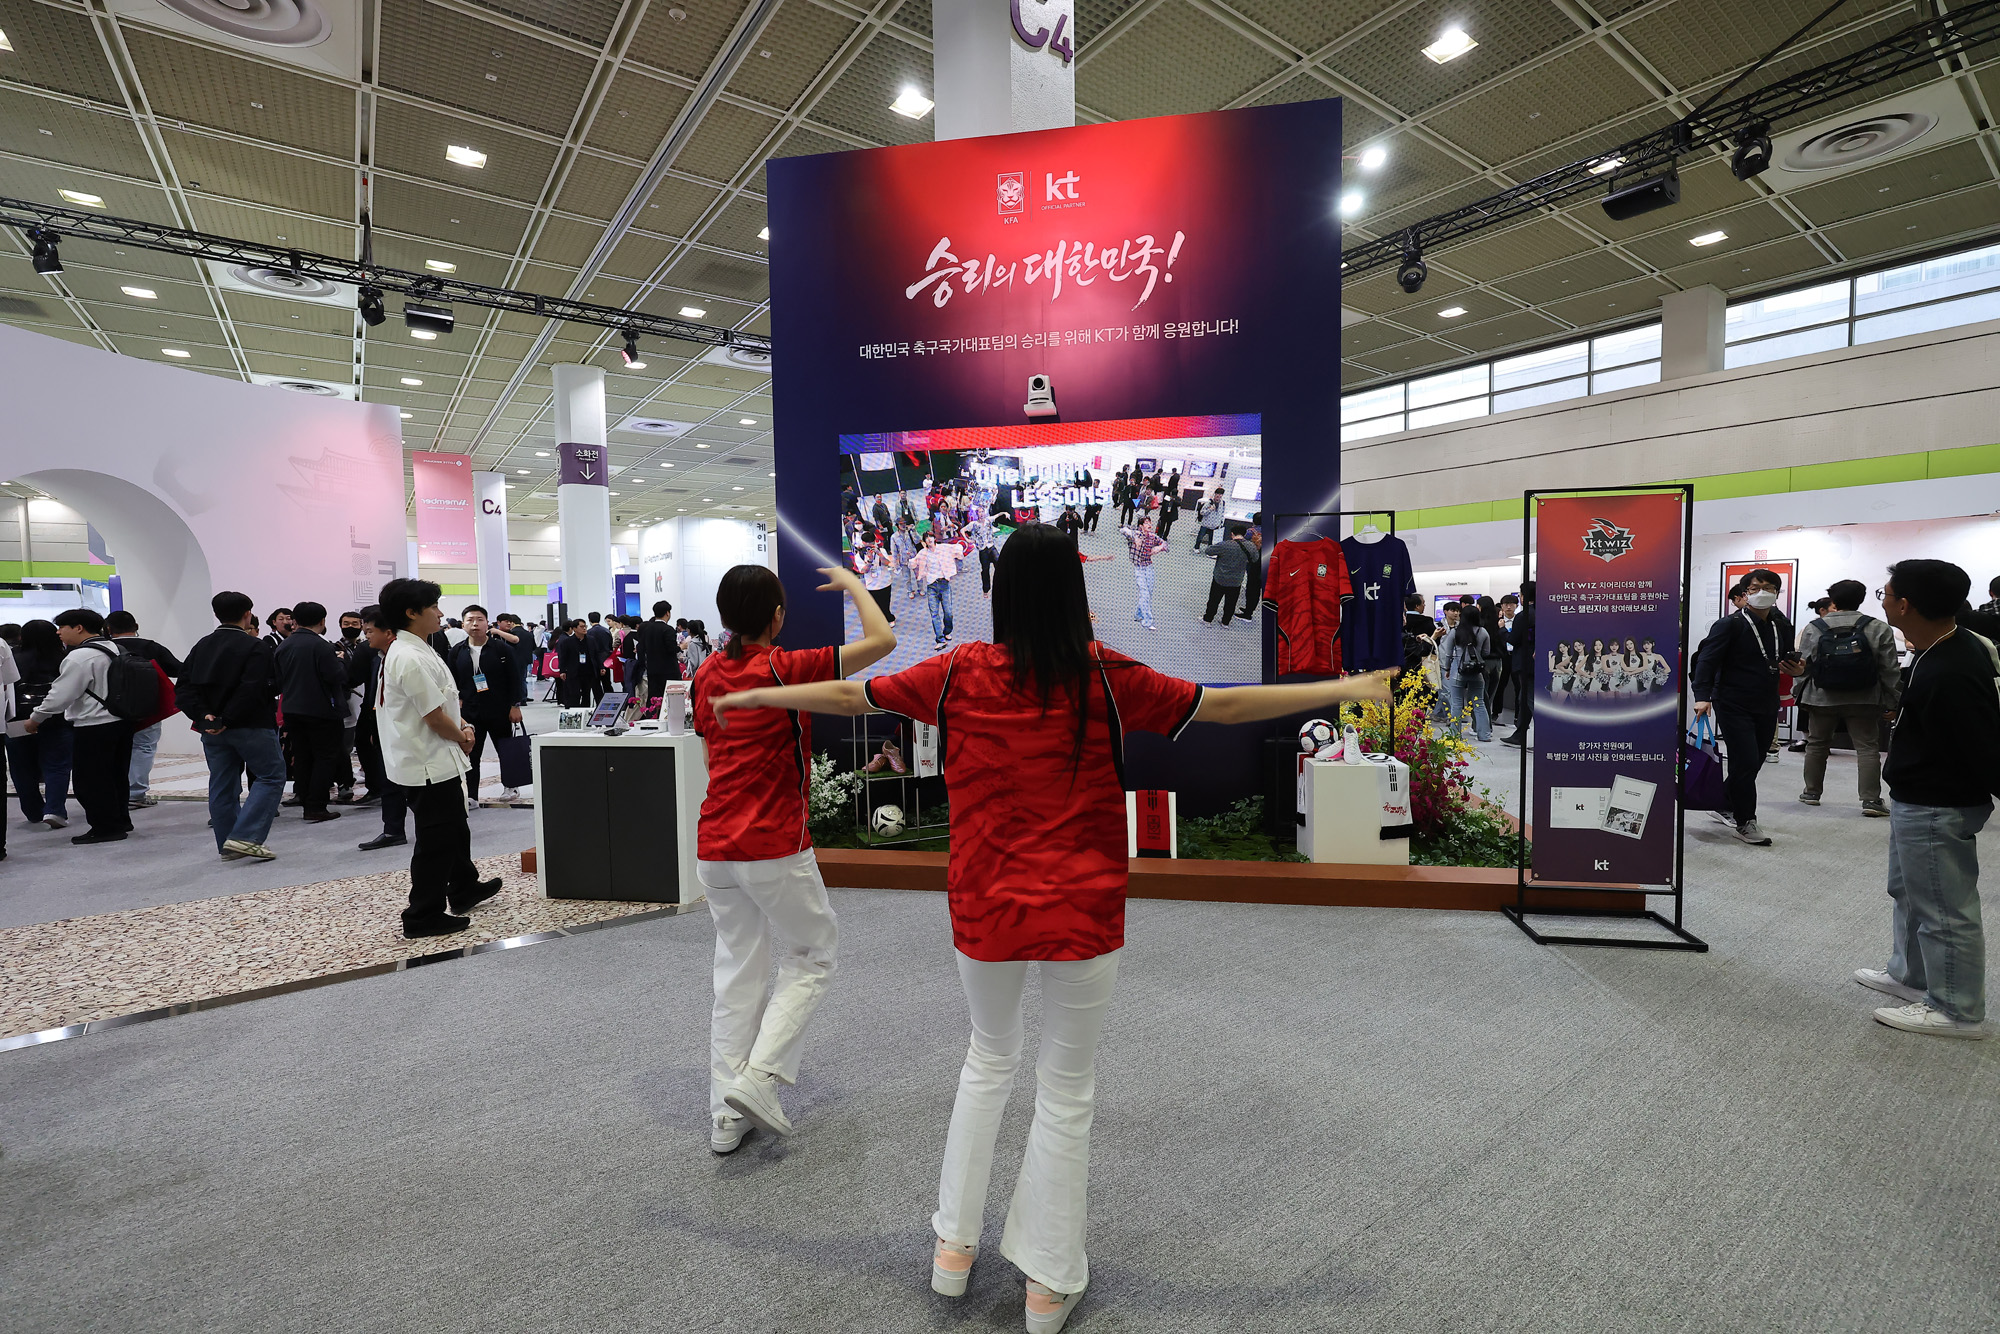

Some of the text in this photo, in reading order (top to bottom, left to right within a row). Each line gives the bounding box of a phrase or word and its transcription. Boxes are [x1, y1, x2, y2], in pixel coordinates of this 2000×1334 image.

[1010, 0, 1073, 63] C4
[1046, 170, 1080, 201] kt
[1003, 216, 1019, 225] KFA
[906, 230, 1186, 311] 승리의 대한민국!
[859, 319, 1239, 359] 대한민국 축구국가대표팀의 승리를 위해 KT가 함께 응원합니다!
[575, 449, 598, 459] 소화전
[482, 498, 502, 515] C4
[756, 522, 766, 552] 케이티
[1589, 539, 1602, 548] kt
[655, 571, 663, 593] kt
[1563, 581, 1575, 590] kt
[1599, 581, 1637, 589] 치어리더와
[1638, 580, 1653, 588] 함께
[1363, 582, 1381, 601] kt
[1548, 592, 1670, 602] 대한민국 축구국가대표팀을 응원하는
[1560, 604, 1658, 614] 댄스 챌린지에 참여해보세요!
[1578, 741, 1633, 750] 참가자 전원에게
[1546, 752, 1667, 762] 특별한 기념 사진을 인화해드립니다.
[1575, 803, 1584, 811] kt
[1594, 859, 1610, 871] kt
